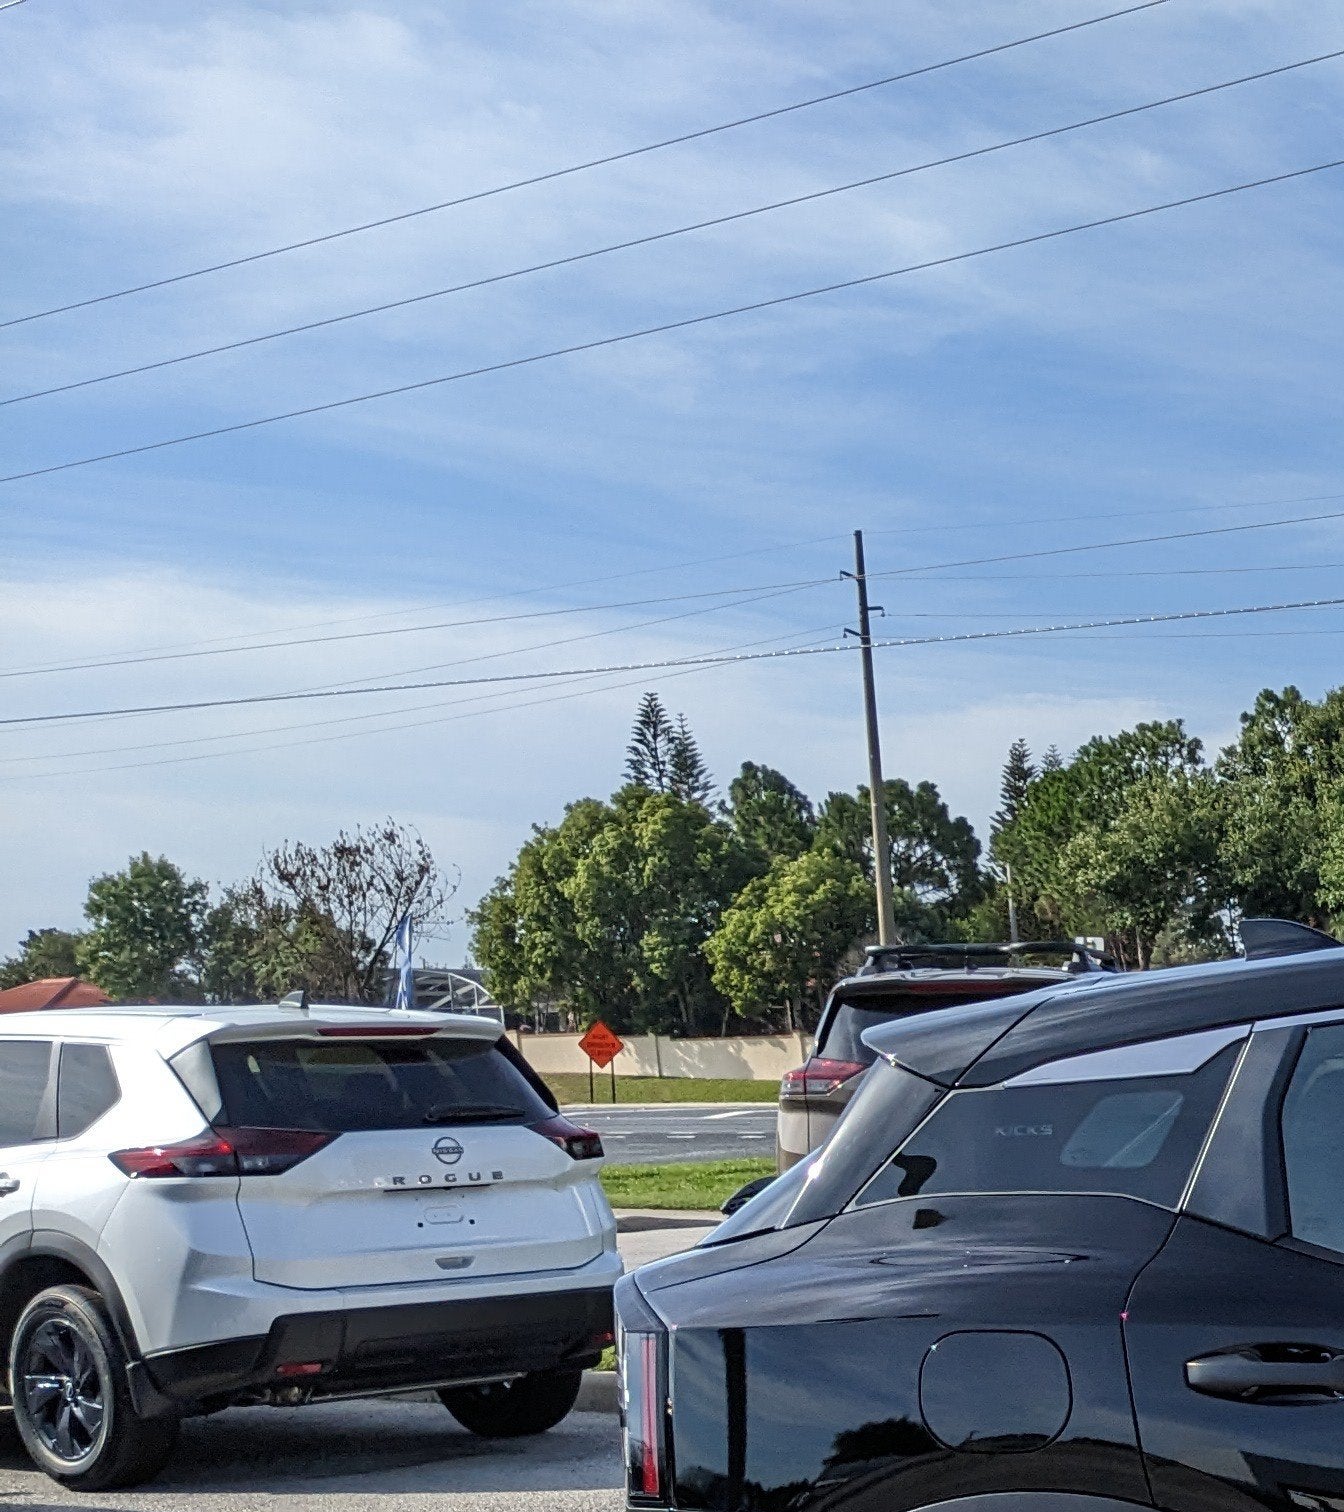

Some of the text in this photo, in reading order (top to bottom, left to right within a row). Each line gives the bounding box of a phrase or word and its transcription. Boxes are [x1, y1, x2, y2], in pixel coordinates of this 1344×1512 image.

[994, 1124, 1054, 1136] KICKS
[432, 1146, 464, 1155] NISSAN
[392, 1170, 504, 1186] ROGUE
